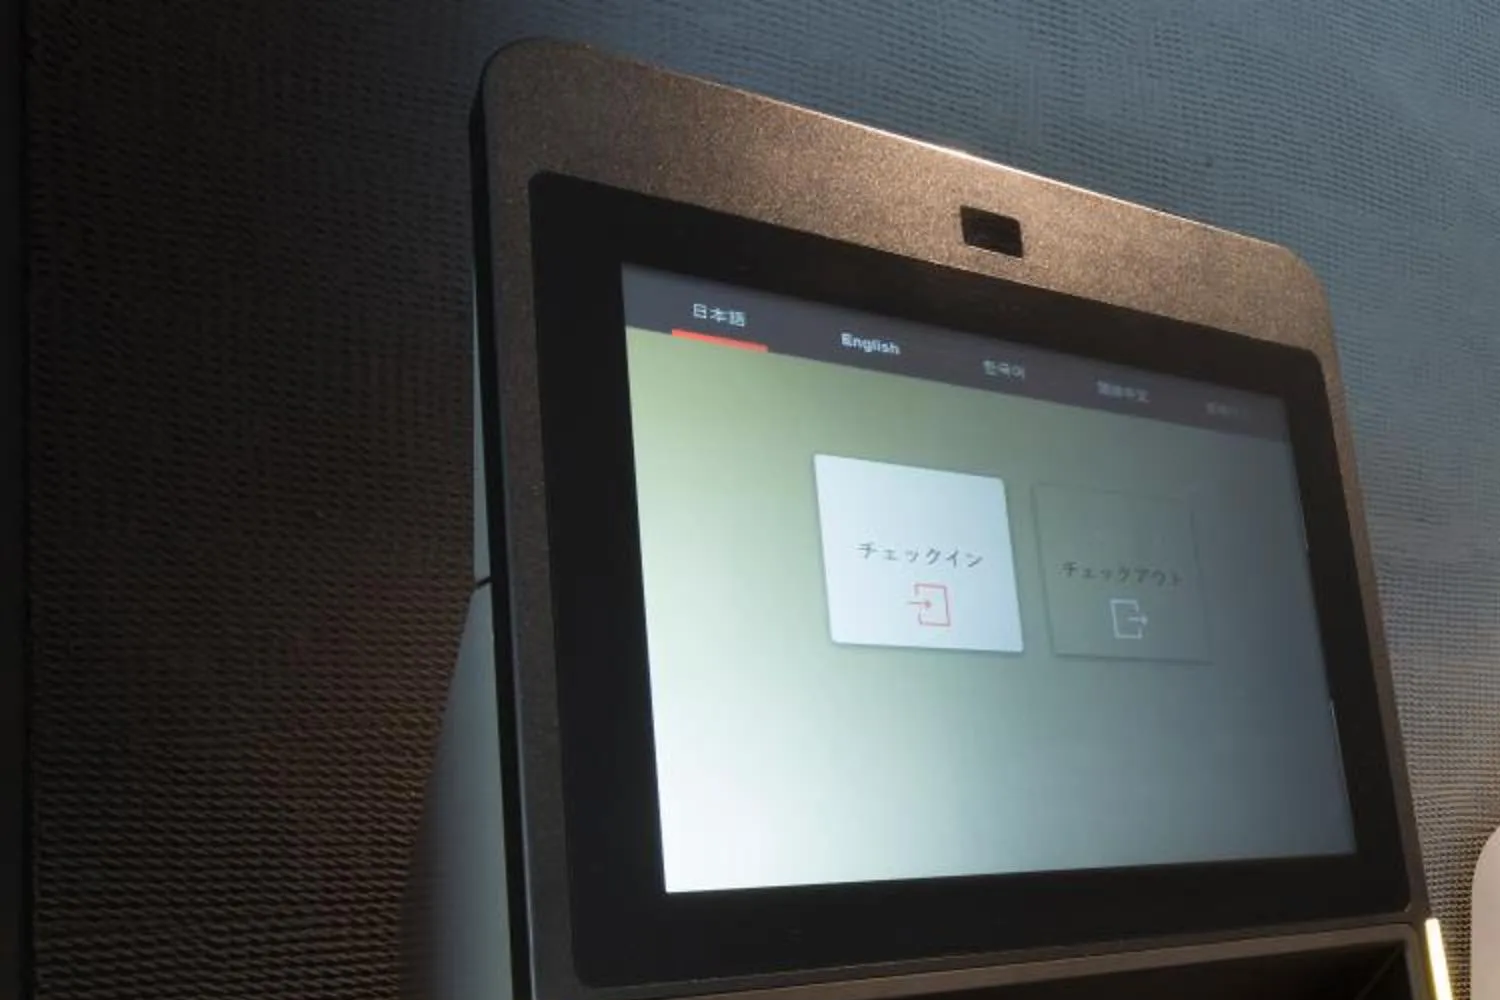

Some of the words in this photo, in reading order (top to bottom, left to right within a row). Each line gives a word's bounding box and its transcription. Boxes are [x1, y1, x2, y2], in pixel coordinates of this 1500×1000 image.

[693, 302, 747, 328] 日本語
[841, 332, 900, 355] English
[857, 541, 984, 568] チェックイン
[1060, 561, 1184, 586] チェックアウト
